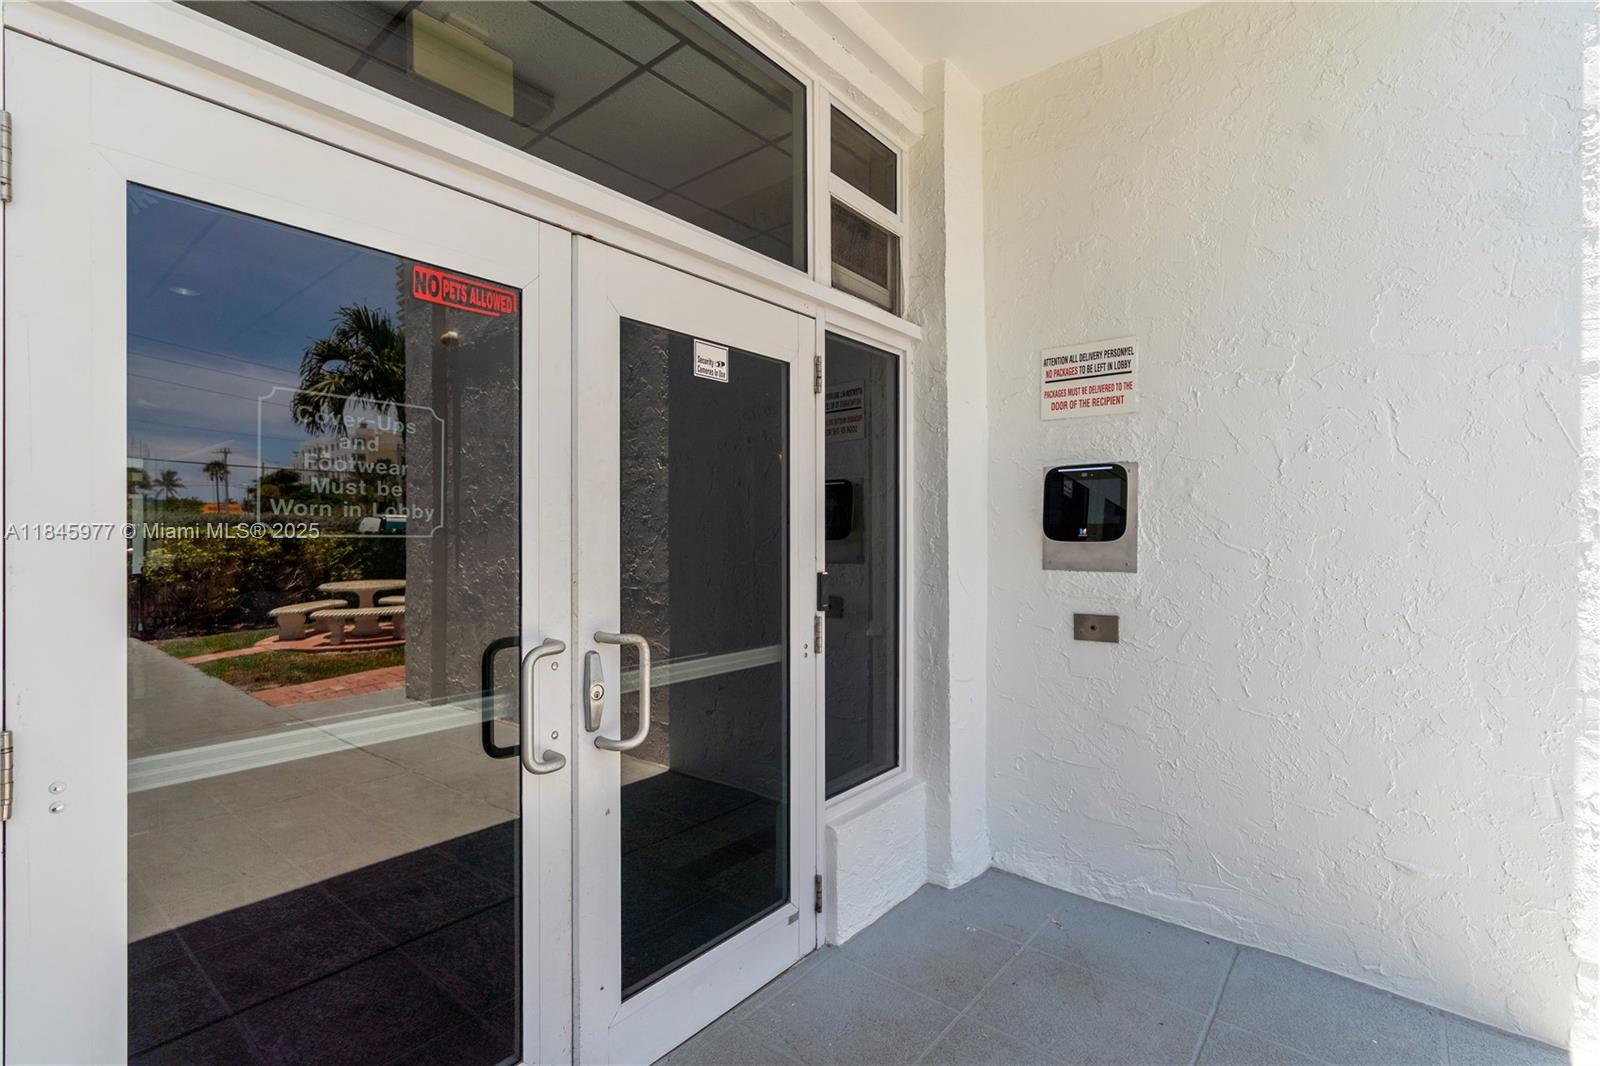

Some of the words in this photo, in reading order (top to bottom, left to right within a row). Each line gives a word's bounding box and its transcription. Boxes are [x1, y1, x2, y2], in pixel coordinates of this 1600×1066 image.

[415, 270, 440, 298] NO
[443, 279, 467, 302] PETS
[469, 287, 513, 314] ALLOWED
[1043, 355, 1068, 367] ATTENTION
[1069, 354, 1078, 364] ALL
[1079, 350, 1103, 362] DELIVERY
[1103, 346, 1134, 359] PERSONNEL
[1045, 370, 1053, 379] NO
[1053, 366, 1078, 378] PACKAGES
[1079, 365, 1085, 374] TO
[1087, 364, 1093, 373] BE
[1094, 362, 1106, 372] LEFT
[1107, 362, 1113, 371] IN
[1113, 360, 1131, 370] LOBBY
[1044, 389, 1066, 399] PACKAGES
[1068, 387, 1080, 396] MUST
[1082, 386, 1087, 395] BE
[1089, 383, 1114, 394] DELIVERED
[1116, 382, 1122, 391] TO
[1123, 381, 1133, 390] THE
[1051, 402, 1068, 411] DOOR
[1069, 400, 1077, 410] OF
[1079, 398, 1090, 408] THE
[1091, 395, 1124, 407] RECIPIENT
[299, 405, 417, 434] Cover-Ups
[340, 436, 380, 452] and
[303, 452, 409, 476] Footwear
[310, 477, 367, 495] Must
[377, 481, 403, 497] be
[270, 498, 332, 516] Worn
[344, 501, 361, 517] in
[373, 502, 435, 522] Lobby
